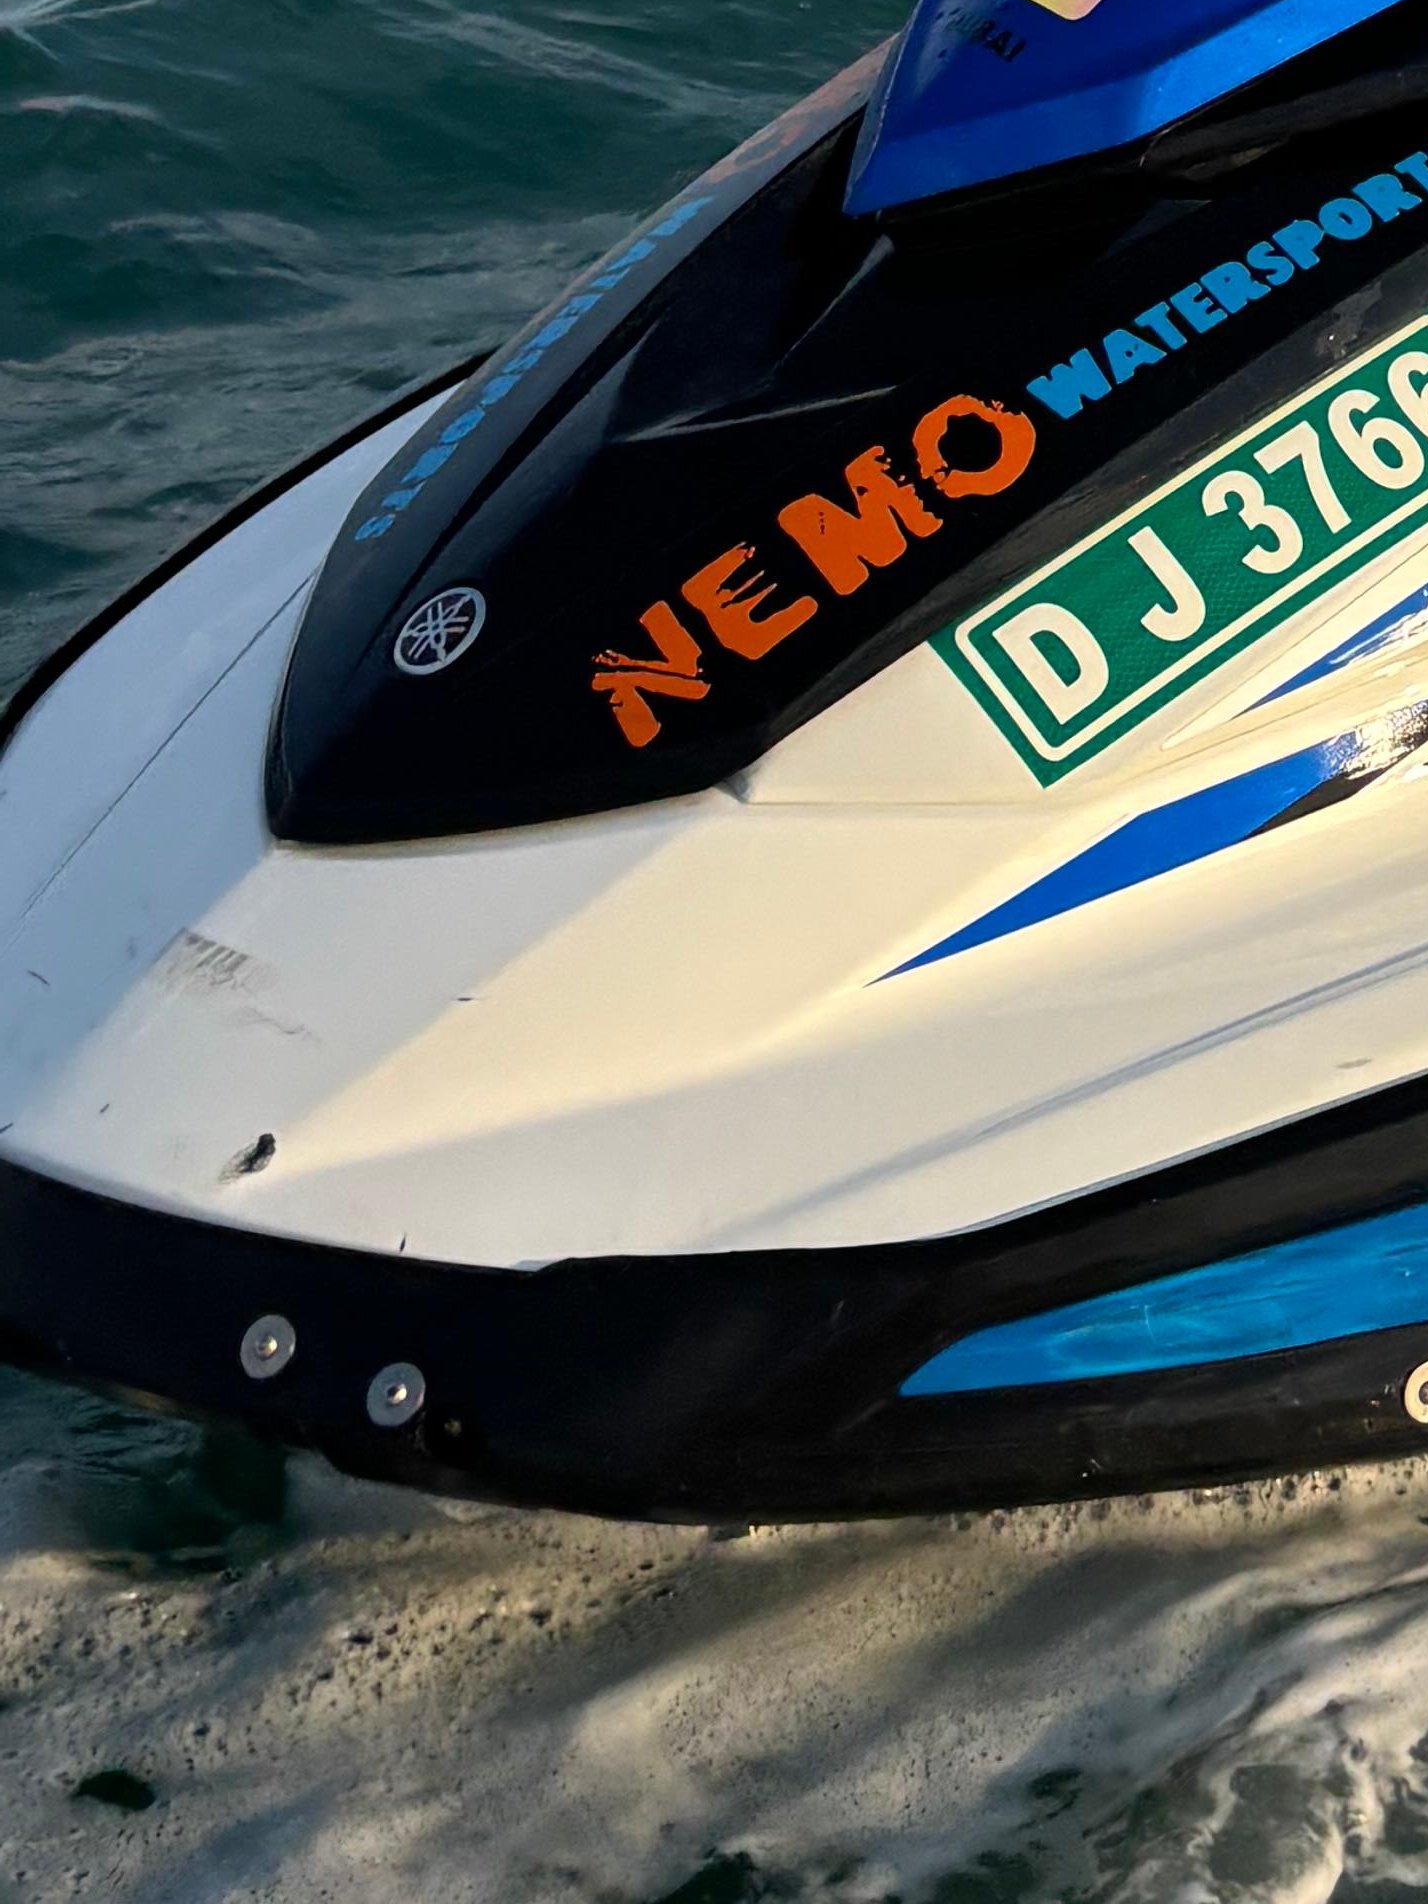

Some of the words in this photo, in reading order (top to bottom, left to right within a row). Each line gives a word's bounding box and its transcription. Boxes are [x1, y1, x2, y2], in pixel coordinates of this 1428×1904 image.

[591, 394, 1036, 747] NEMO
[992, 603, 1109, 725] D
[1127, 526, 1206, 641] J
